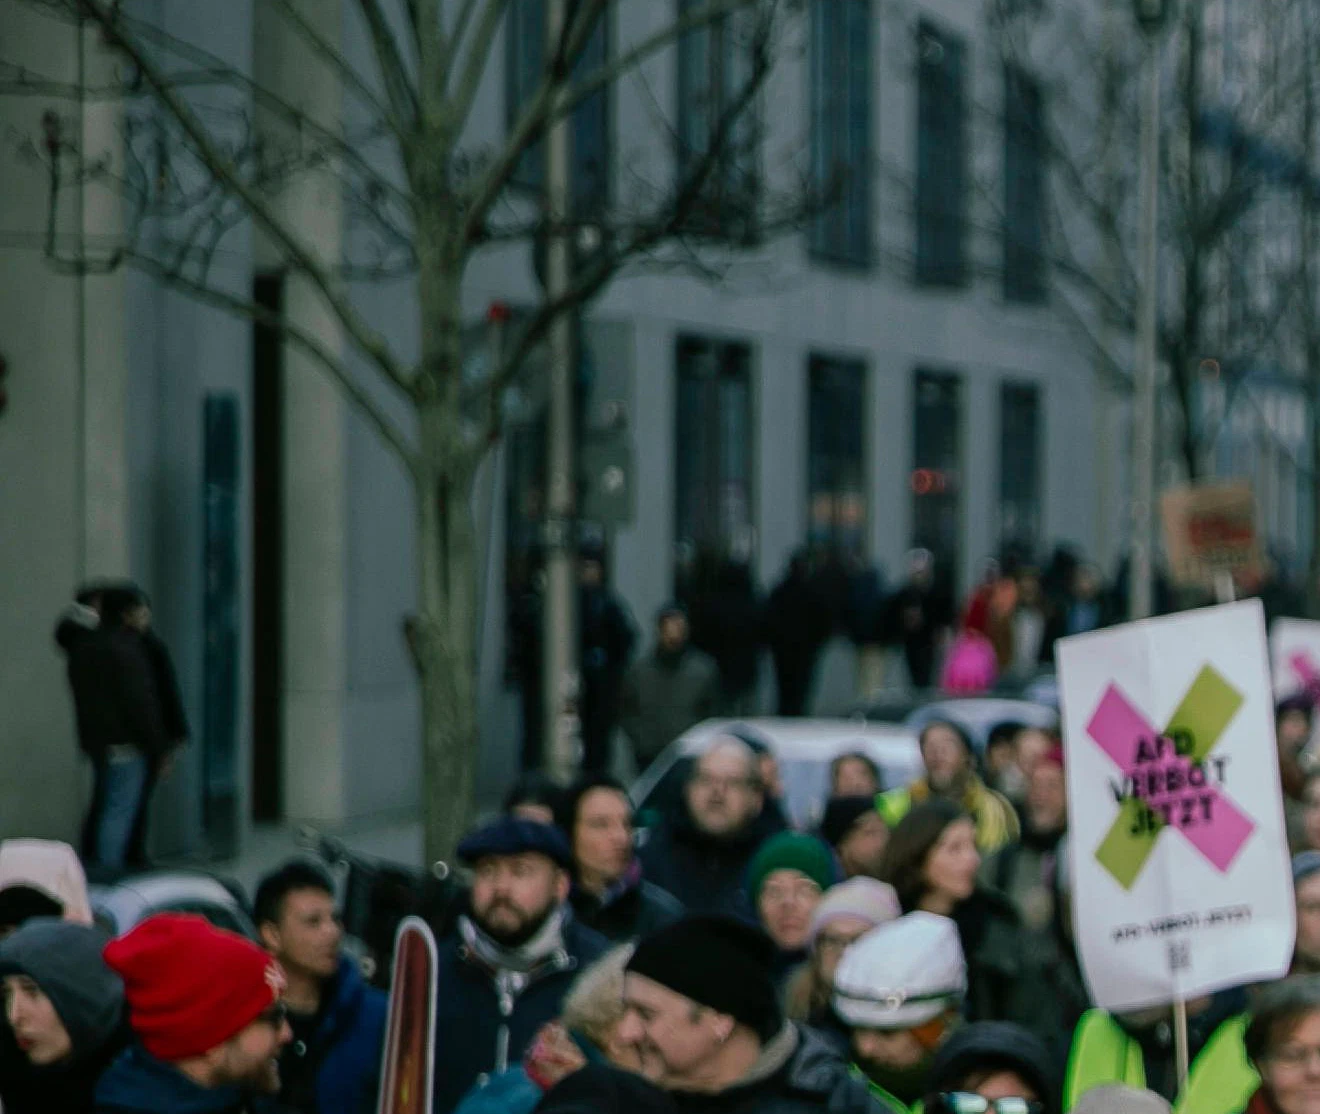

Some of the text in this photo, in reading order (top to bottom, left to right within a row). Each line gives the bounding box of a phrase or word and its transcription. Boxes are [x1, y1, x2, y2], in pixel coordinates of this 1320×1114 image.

[1134, 726, 1197, 764] AFD
[1108, 755, 1231, 803] VERBOT
[1129, 794, 1214, 838] JETZT
